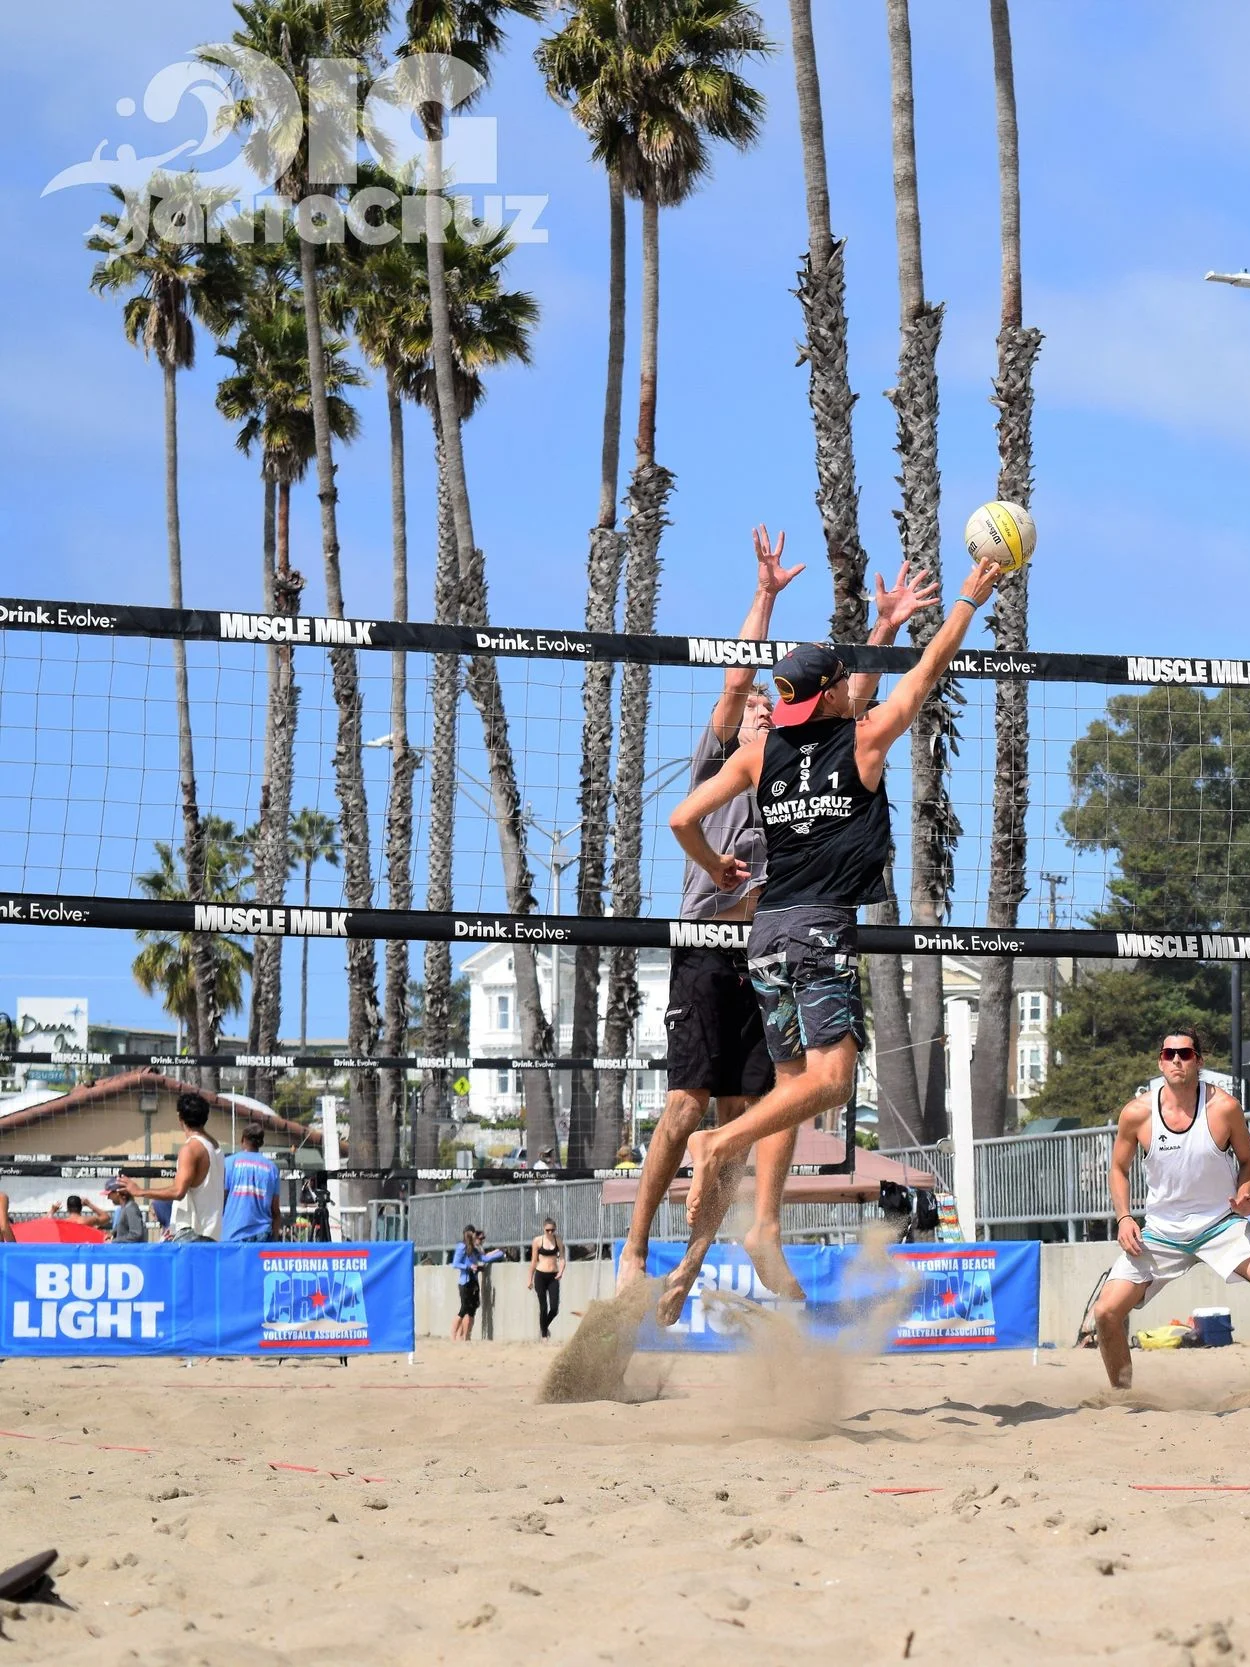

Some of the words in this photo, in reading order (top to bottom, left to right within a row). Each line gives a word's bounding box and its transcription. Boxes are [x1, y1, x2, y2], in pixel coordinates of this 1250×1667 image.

[219, 613, 311, 642] MUSCLE
[688, 639, 774, 666] MUSCLE
[1127, 657, 1208, 683] MUSCLE
[827, 771, 838, 789] 1
[762, 799, 806, 816] SANTA
[809, 795, 853, 809] CRUZ
[194, 905, 286, 934] MUSCLE
[1116, 934, 1199, 958] MUSCLE
[22, 1014, 75, 1035] Dream
[263, 1258, 329, 1272] CALIFORNIA
[332, 1258, 368, 1271] BEACH
[962, 1258, 996, 1271] BEACH
[35, 1263, 145, 1299] BUD
[12, 1301, 164, 1338] LIGHT
[263, 1330, 313, 1341] VOLLEYBALL
[314, 1329, 368, 1339] ASSOCIATION
[944, 1327, 995, 1337] ASSOCIATION
